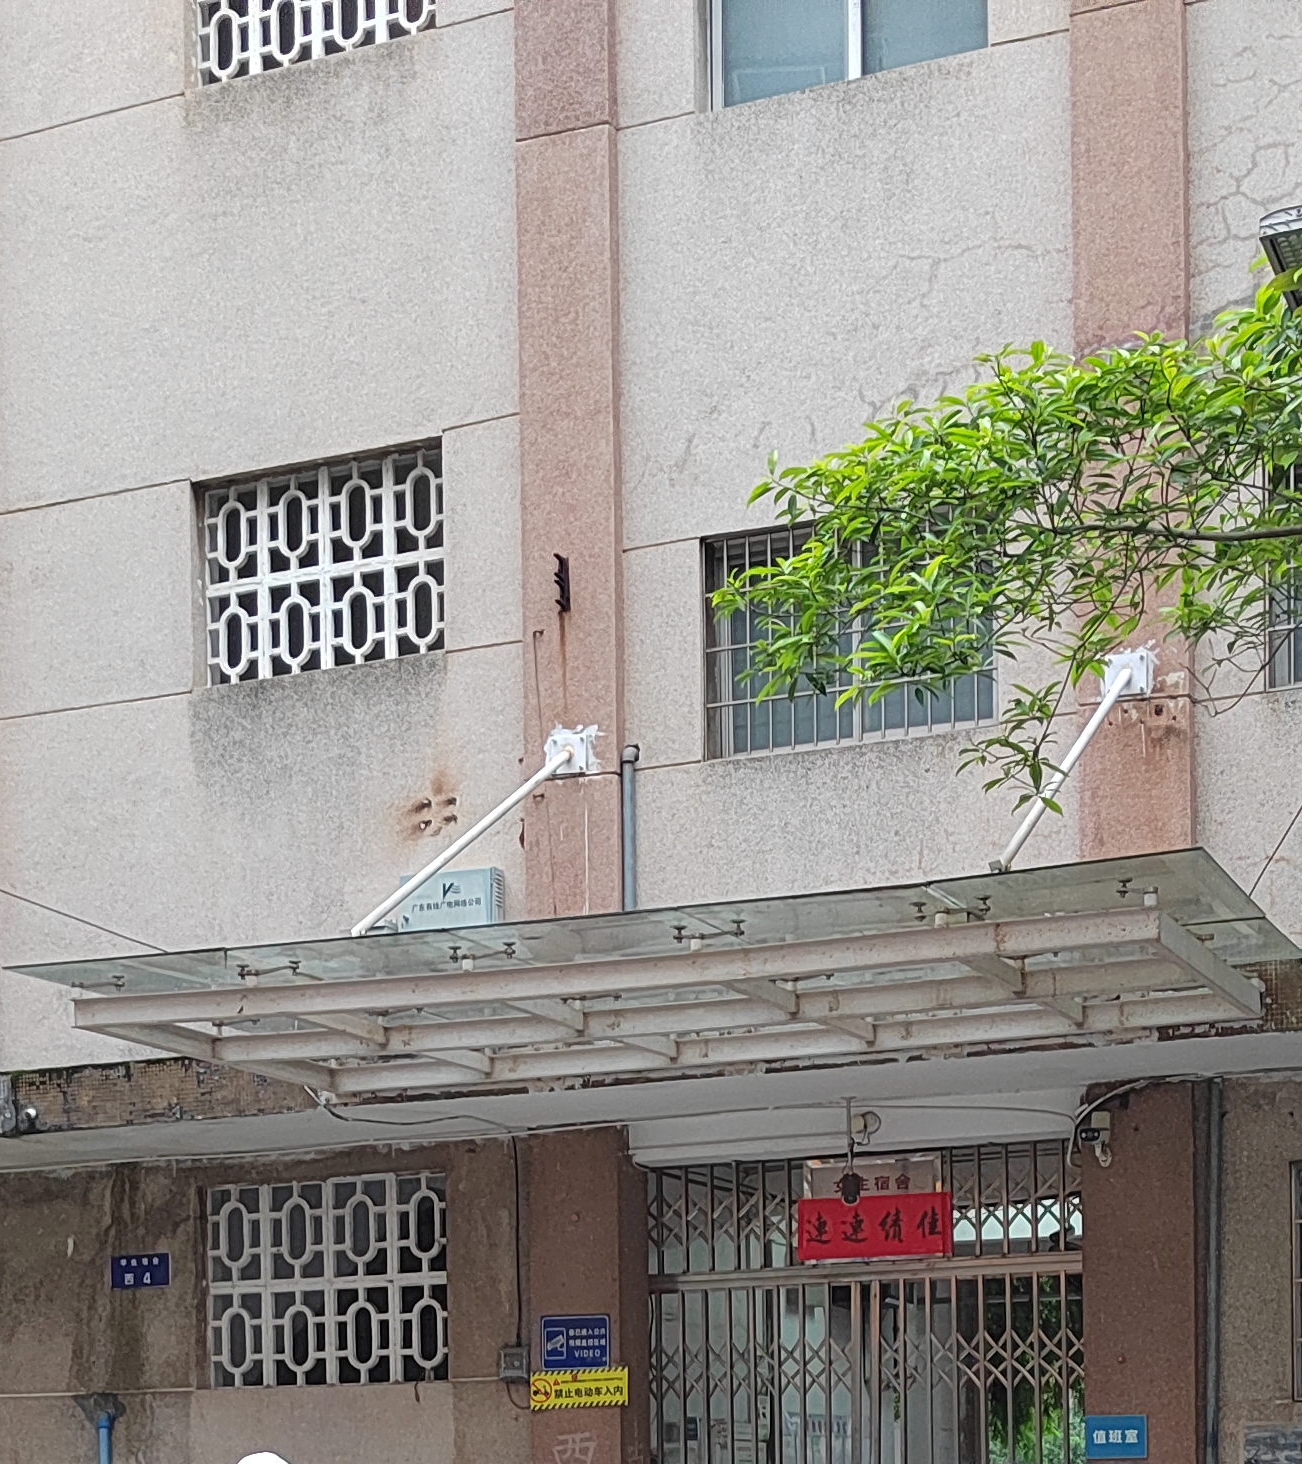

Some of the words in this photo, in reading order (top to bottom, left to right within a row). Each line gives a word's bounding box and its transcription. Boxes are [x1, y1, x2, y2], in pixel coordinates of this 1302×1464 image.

[574, 1349, 601, 1358] VIDEO
[554, 1385, 624, 1399] 禁止电动车入内
[1093, 1429, 1139, 1444] 值班室
